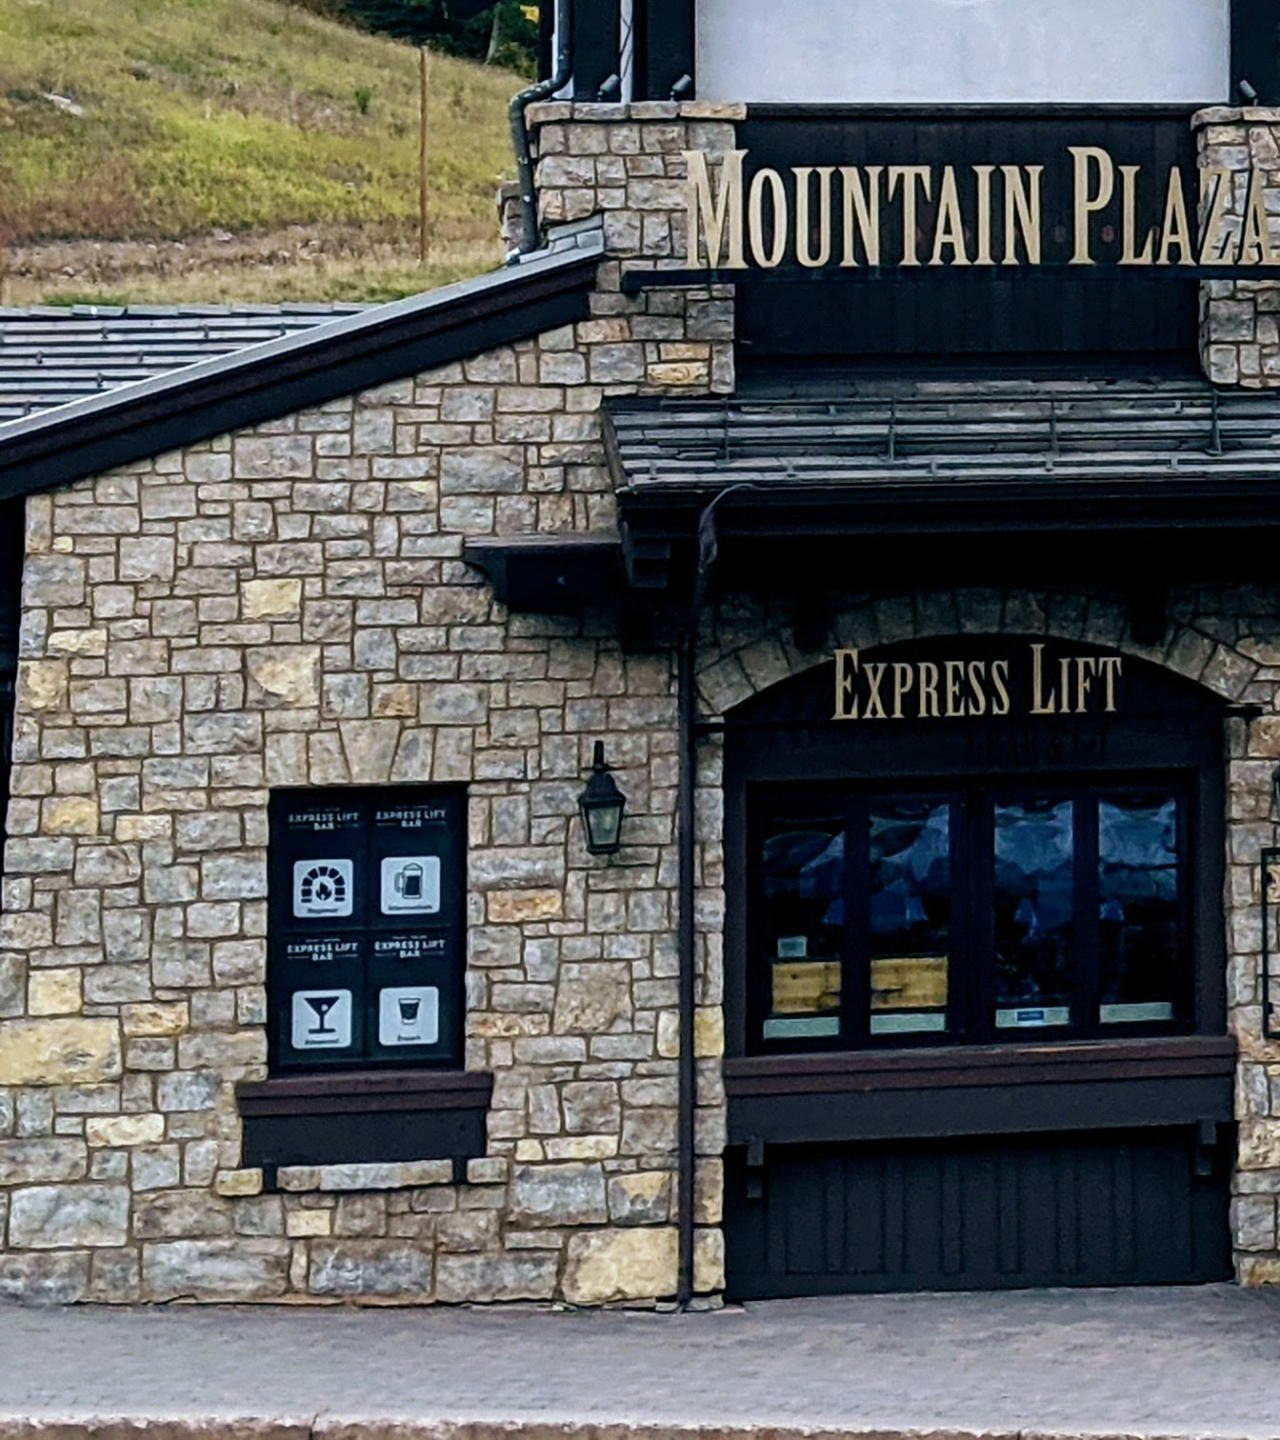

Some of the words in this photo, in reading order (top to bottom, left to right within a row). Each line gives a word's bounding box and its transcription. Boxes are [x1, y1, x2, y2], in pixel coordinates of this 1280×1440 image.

[680, 148, 1045, 269] MOUNTAIN
[1066, 146, 1273, 266] PLAZA
[830, 648, 1011, 720] EXPRESS
[1029, 643, 1122, 714] LIFT
[288, 813, 334, 823] EXPRESS
[336, 812, 360, 823] LIFT
[313, 821, 335, 831] BAR
[401, 819, 423, 828] BAR
[287, 944, 333, 954] EXPRESS
[335, 942, 359, 952] LIFT
[374, 940, 420, 951] EXPRESS
[422, 939, 446, 949] LIFT
[312, 952, 334, 961] BAR
[399, 949, 421, 959] BAR
